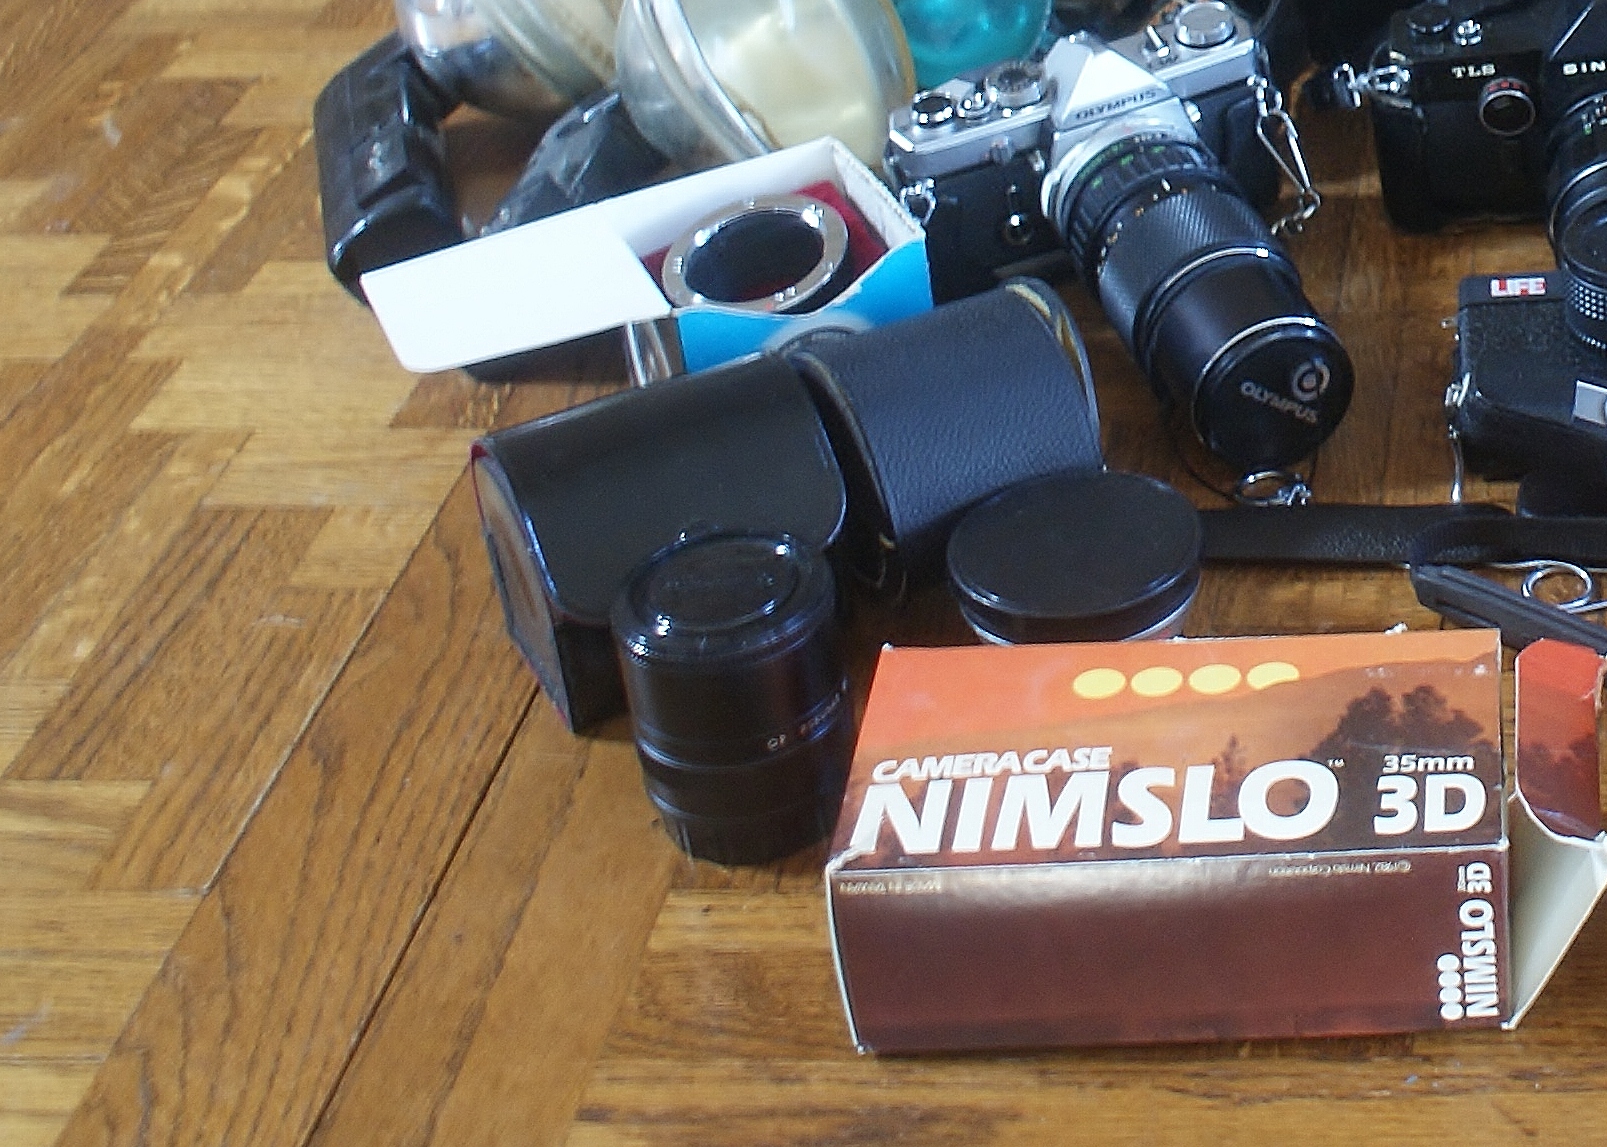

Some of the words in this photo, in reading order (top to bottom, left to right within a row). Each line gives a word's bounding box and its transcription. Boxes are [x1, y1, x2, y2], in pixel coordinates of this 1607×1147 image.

[1451, 62, 1497, 80] TLS
[1076, 90, 1157, 120] OLYMPUS
[1240, 381, 1318, 424] OLYMPUS
[1382, 754, 1475, 774] 35mm
[847, 759, 1340, 855] NIMSLO
[1373, 773, 1487, 837] 3D
[1466, 860, 1493, 894] 3D
[1459, 898, 1500, 1018] NIMSLO
